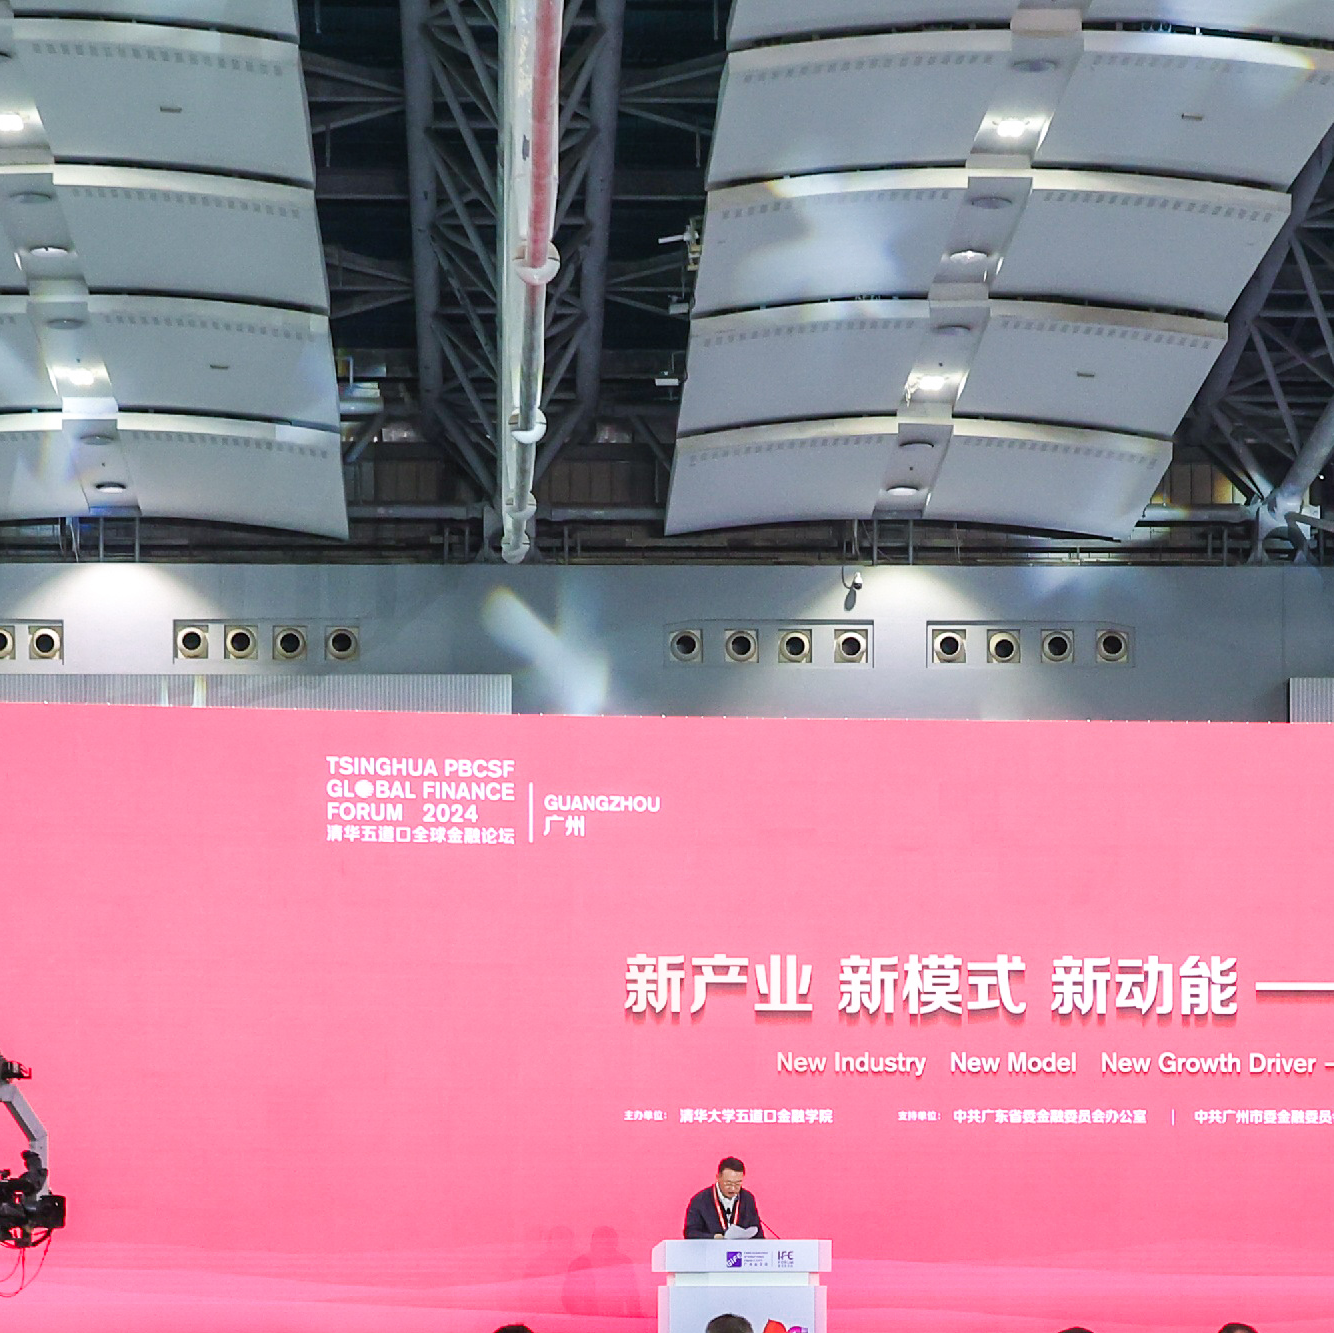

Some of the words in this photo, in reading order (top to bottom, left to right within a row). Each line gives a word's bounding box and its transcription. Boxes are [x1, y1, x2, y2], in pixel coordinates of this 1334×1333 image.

[326, 756, 438, 777] TSINGHUA
[444, 759, 515, 779] PBCSF
[423, 782, 515, 801] FINANCE
[327, 803, 403, 822] FORUM
[423, 804, 479, 823] 2024
[543, 795, 661, 813] GUANGZHOU
[326, 825, 515, 845] 清华五道口全球金融论坛
[543, 815, 585, 837] 广州
[624, 953, 813, 1014] 新产业
[839, 954, 1027, 1015] 新模式
[777, 1052, 827, 1072] New
[834, 1052, 927, 1076] Industry
[950, 1052, 1001, 1072] New
[1008, 1052, 1077, 1072] Model
[1101, 1052, 1152, 1073] New
[1158, 1052, 1241, 1073] Growth
[1250, 1052, 1317, 1073] Driver
[679, 1108, 834, 1124] 清华大学五道口金融学院
[953, 1109, 1147, 1124] 中共广东省委金融委员会办公室
